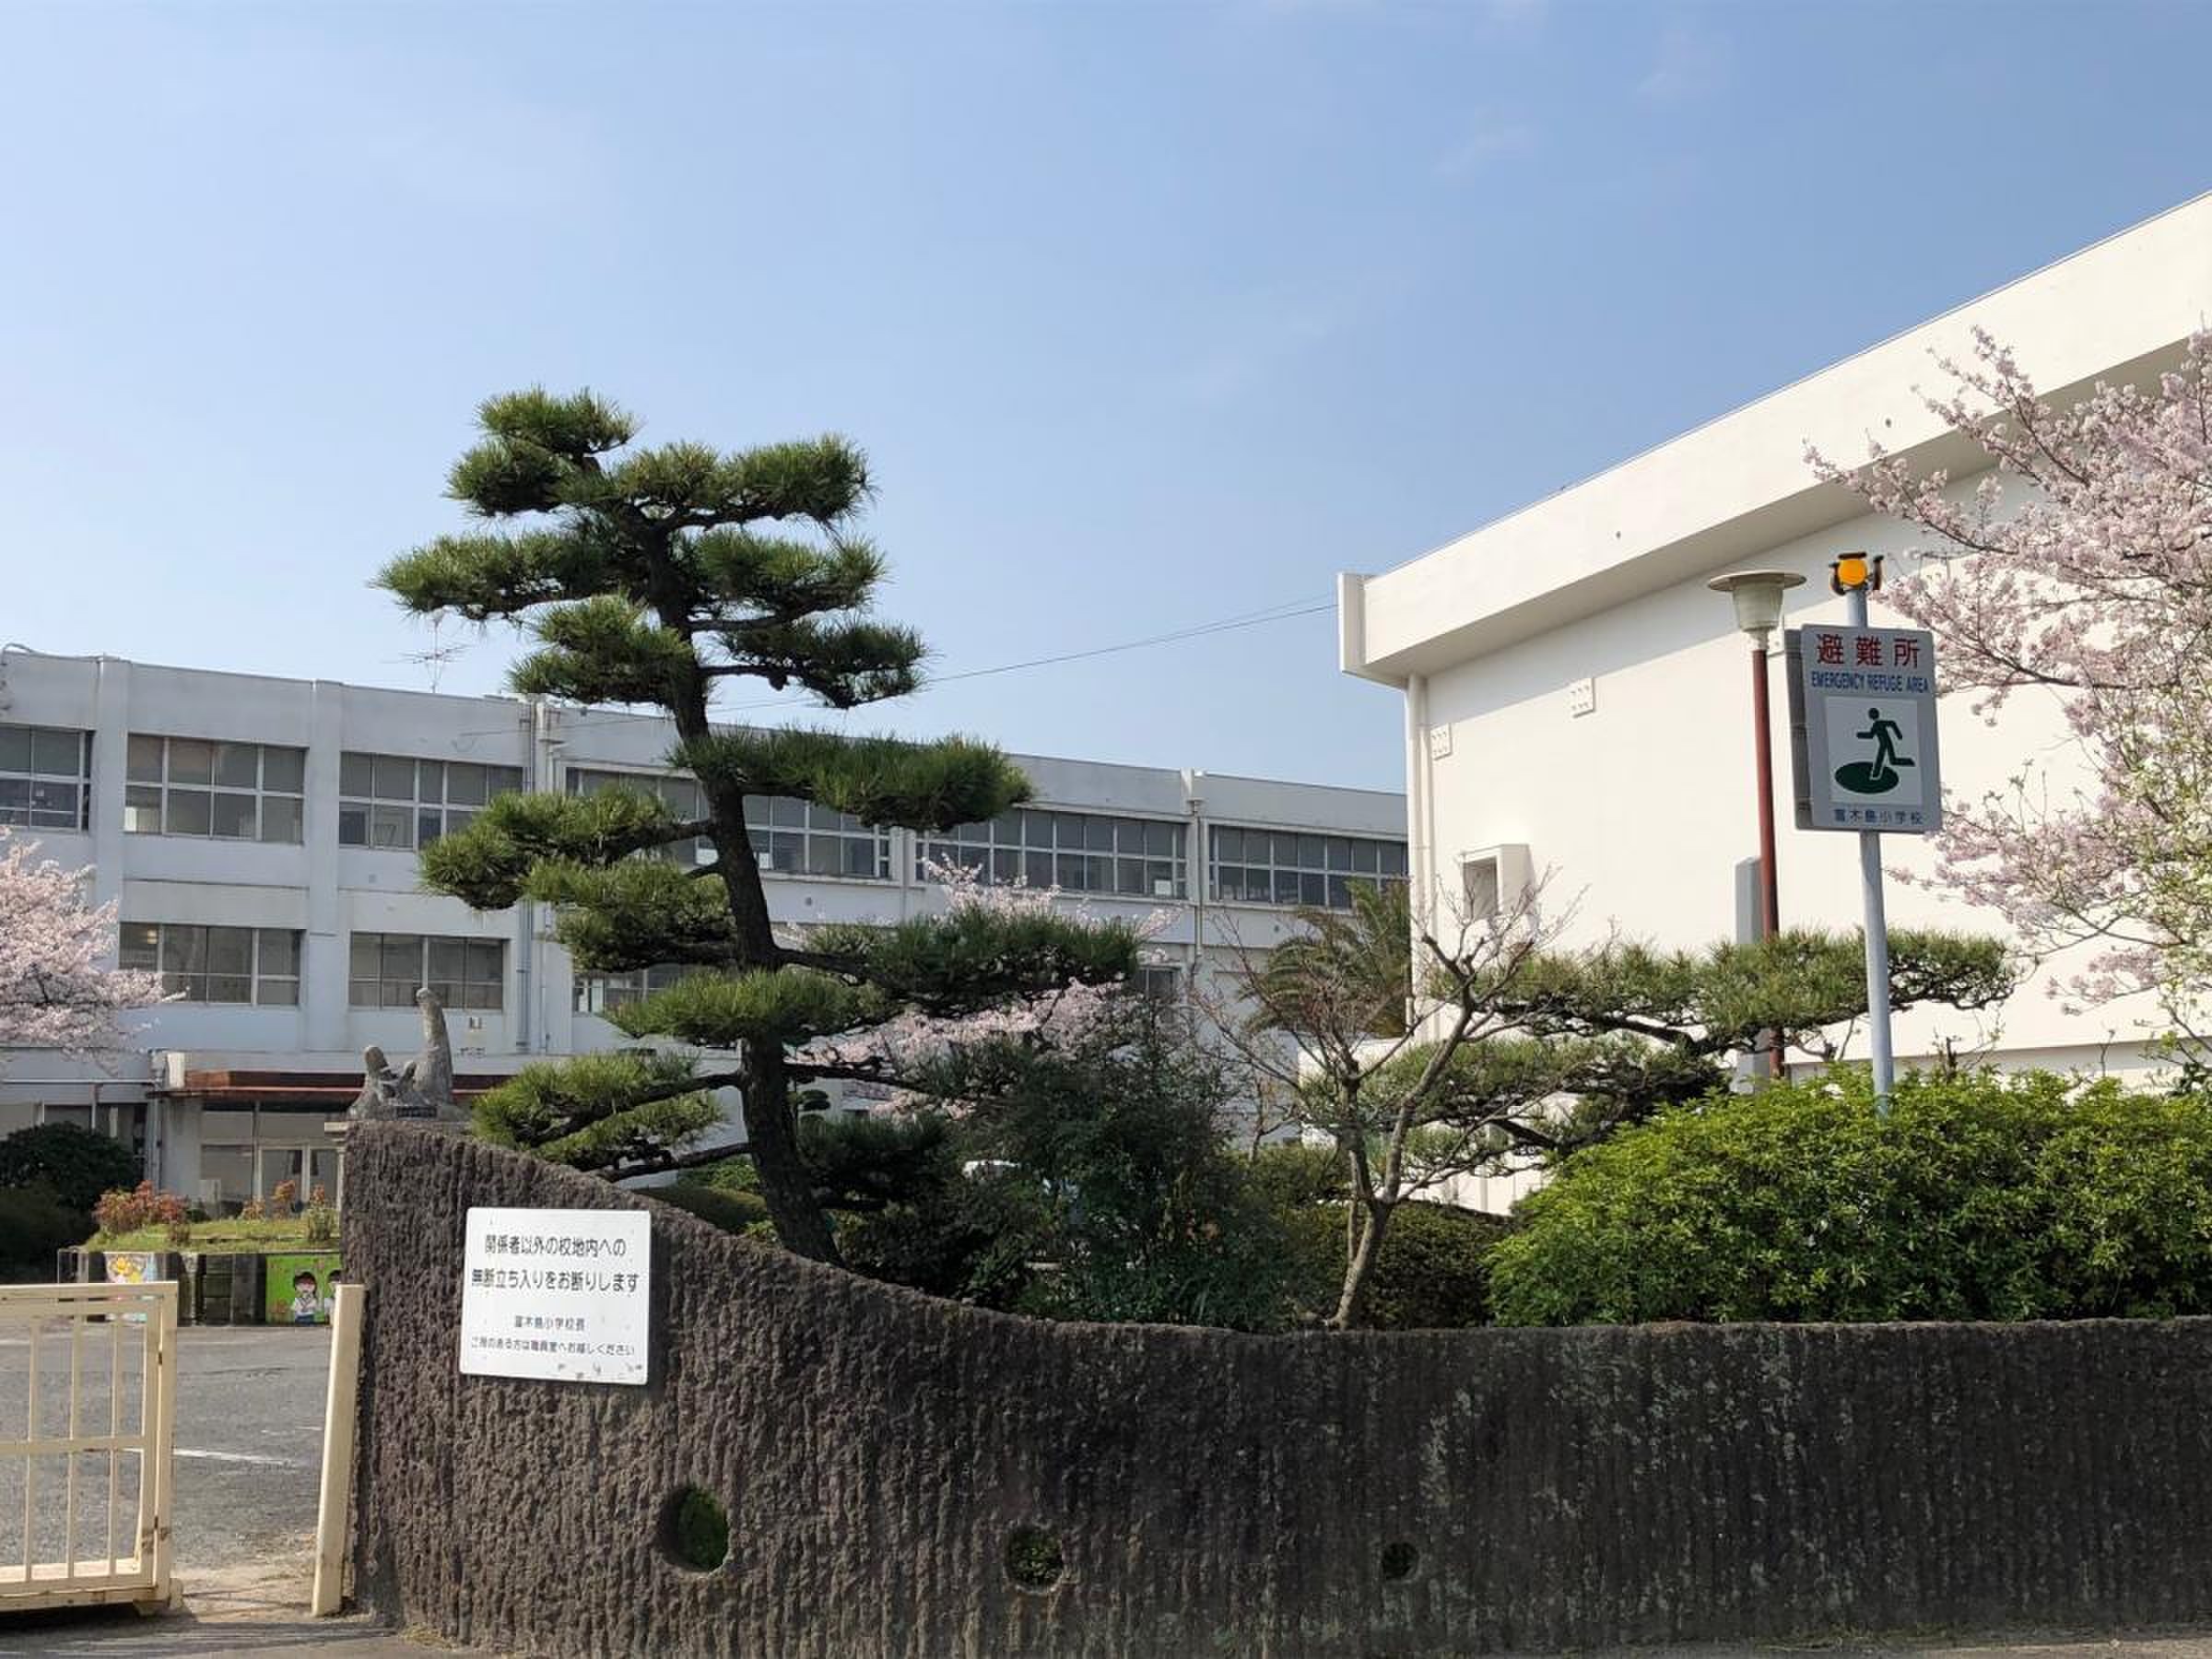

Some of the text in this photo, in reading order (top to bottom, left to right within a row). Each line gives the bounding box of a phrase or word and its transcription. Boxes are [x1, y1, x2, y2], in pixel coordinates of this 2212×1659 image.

[1817, 633, 1921, 668] 避難所
[1811, 671, 1929, 692] EMERGENCY REFUGE AREA
[486, 1234, 627, 1257] 関係者以外の校地内への
[471, 1268, 639, 1292] 無断立ち入りをお断りします
